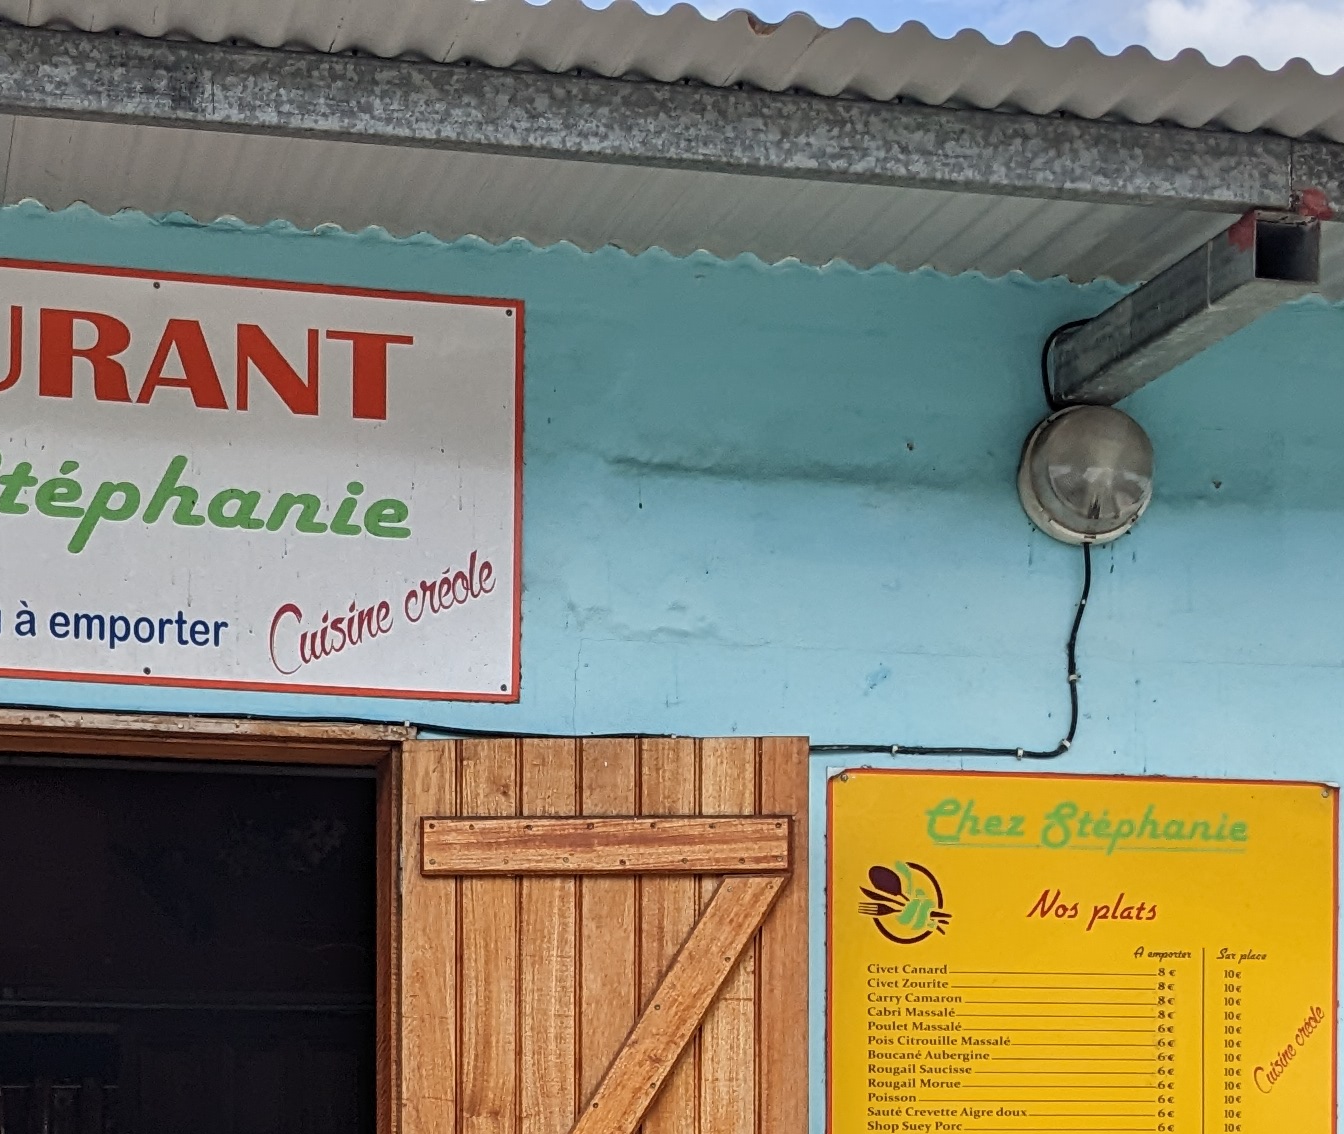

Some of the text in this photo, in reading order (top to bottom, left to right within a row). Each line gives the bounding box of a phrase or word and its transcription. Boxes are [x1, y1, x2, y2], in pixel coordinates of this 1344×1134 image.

[269, 550, 496, 675] Cuisine créole
[14, 601, 37, 636] à
[49, 608, 228, 649] emporter
[926, 798, 1248, 856] Chez Stéphanie
[1026, 889, 1157, 931] Nos plats
[1148, 951, 1191, 962] emporter
[1238, 949, 1267, 964] place
[868, 964, 898, 974] Civet
[903, 965, 947, 974] Canard
[868, 978, 898, 988] Civet
[868, 993, 902, 1005] Carry
[905, 993, 962, 1003] Camaron
[868, 1007, 901, 1016] Cabri
[906, 1008, 955, 1017] Massalé
[868, 1021, 907, 1030] Poulet
[912, 1022, 961, 1031] Massalé
[868, 1036, 894, 1045] Pois
[898, 1036, 957, 1045] Citrouille
[961, 1036, 1010, 1046] Massalé
[1254, 1006, 1324, 1093] Cuisine créole
[868, 1050, 922, 1059] Boucané
[925, 1050, 990, 1062] Aubergine
[868, 1064, 916, 1076] Rougail
[920, 1065, 972, 1074] Saucisse
[868, 1078, 916, 1090] Rougail
[920, 1079, 961, 1088] Morue
[868, 1093, 916, 1102] Poisson
[868, 1107, 902, 1116] Sauté
[906, 1107, 957, 1116] Crevette
[960, 1107, 993, 1119] Aigre
[996, 1107, 1027, 1116] doux
[868, 1121, 899, 1133] Shop
[902, 1121, 932, 1133] Suey
[935, 1122, 962, 1131] Porc
